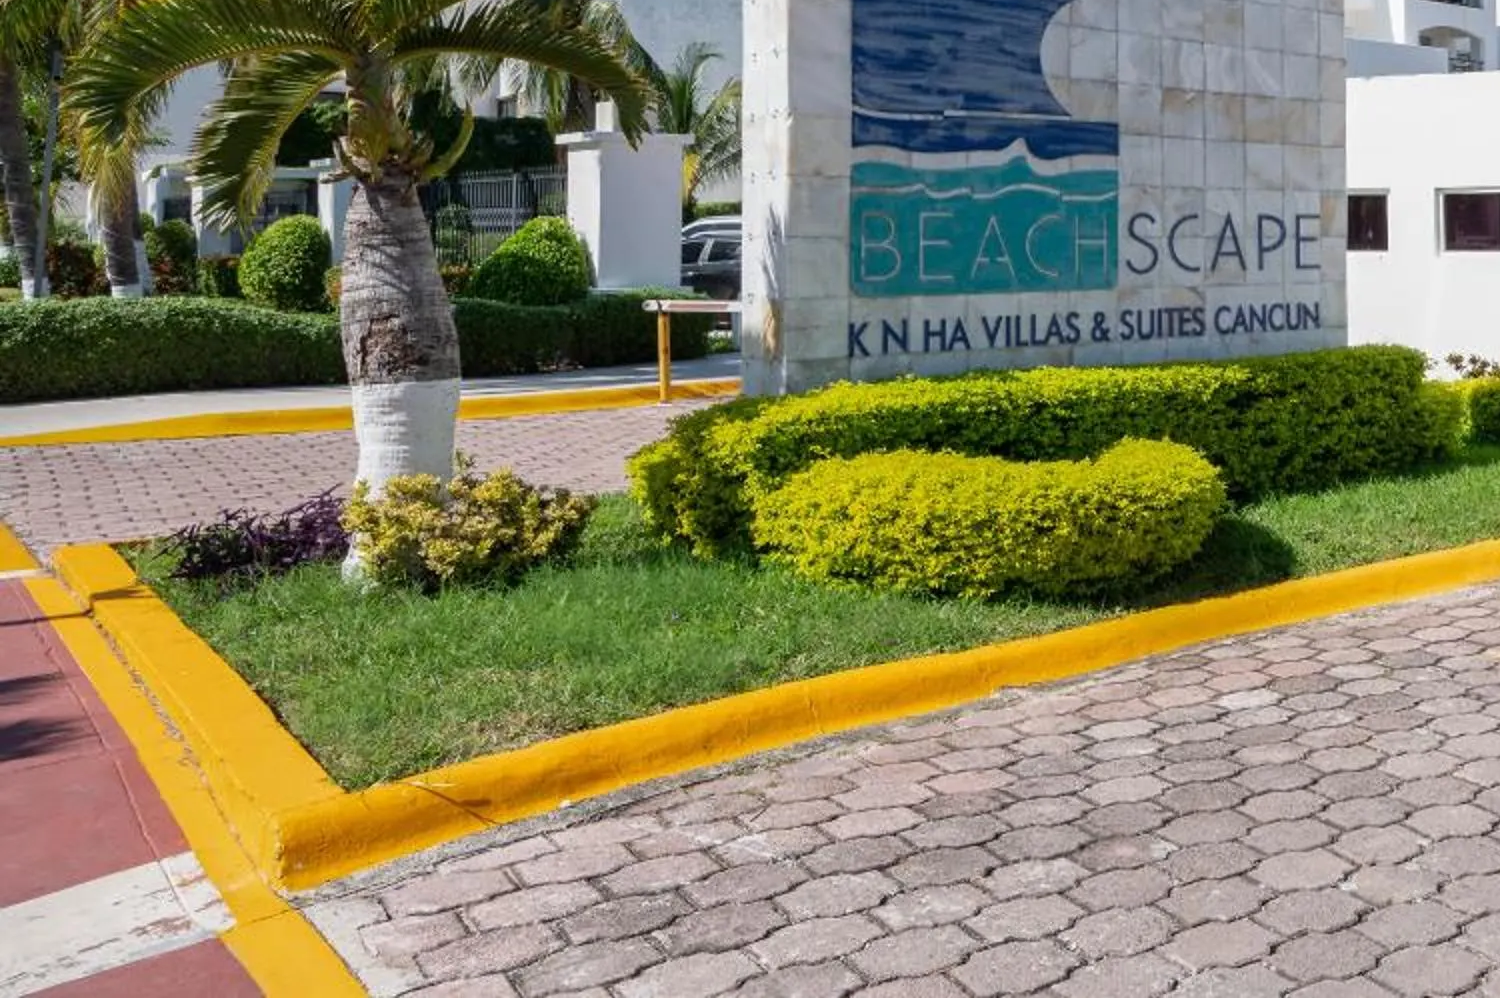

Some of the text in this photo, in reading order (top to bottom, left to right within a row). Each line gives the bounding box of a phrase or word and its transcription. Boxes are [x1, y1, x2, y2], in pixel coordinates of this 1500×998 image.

[923, 316, 971, 352] HA
[982, 311, 1082, 348] VILLAS
[1091, 311, 1110, 342] &
[1119, 308, 1206, 342] SUITES
[1214, 302, 1322, 335] CANCUN
